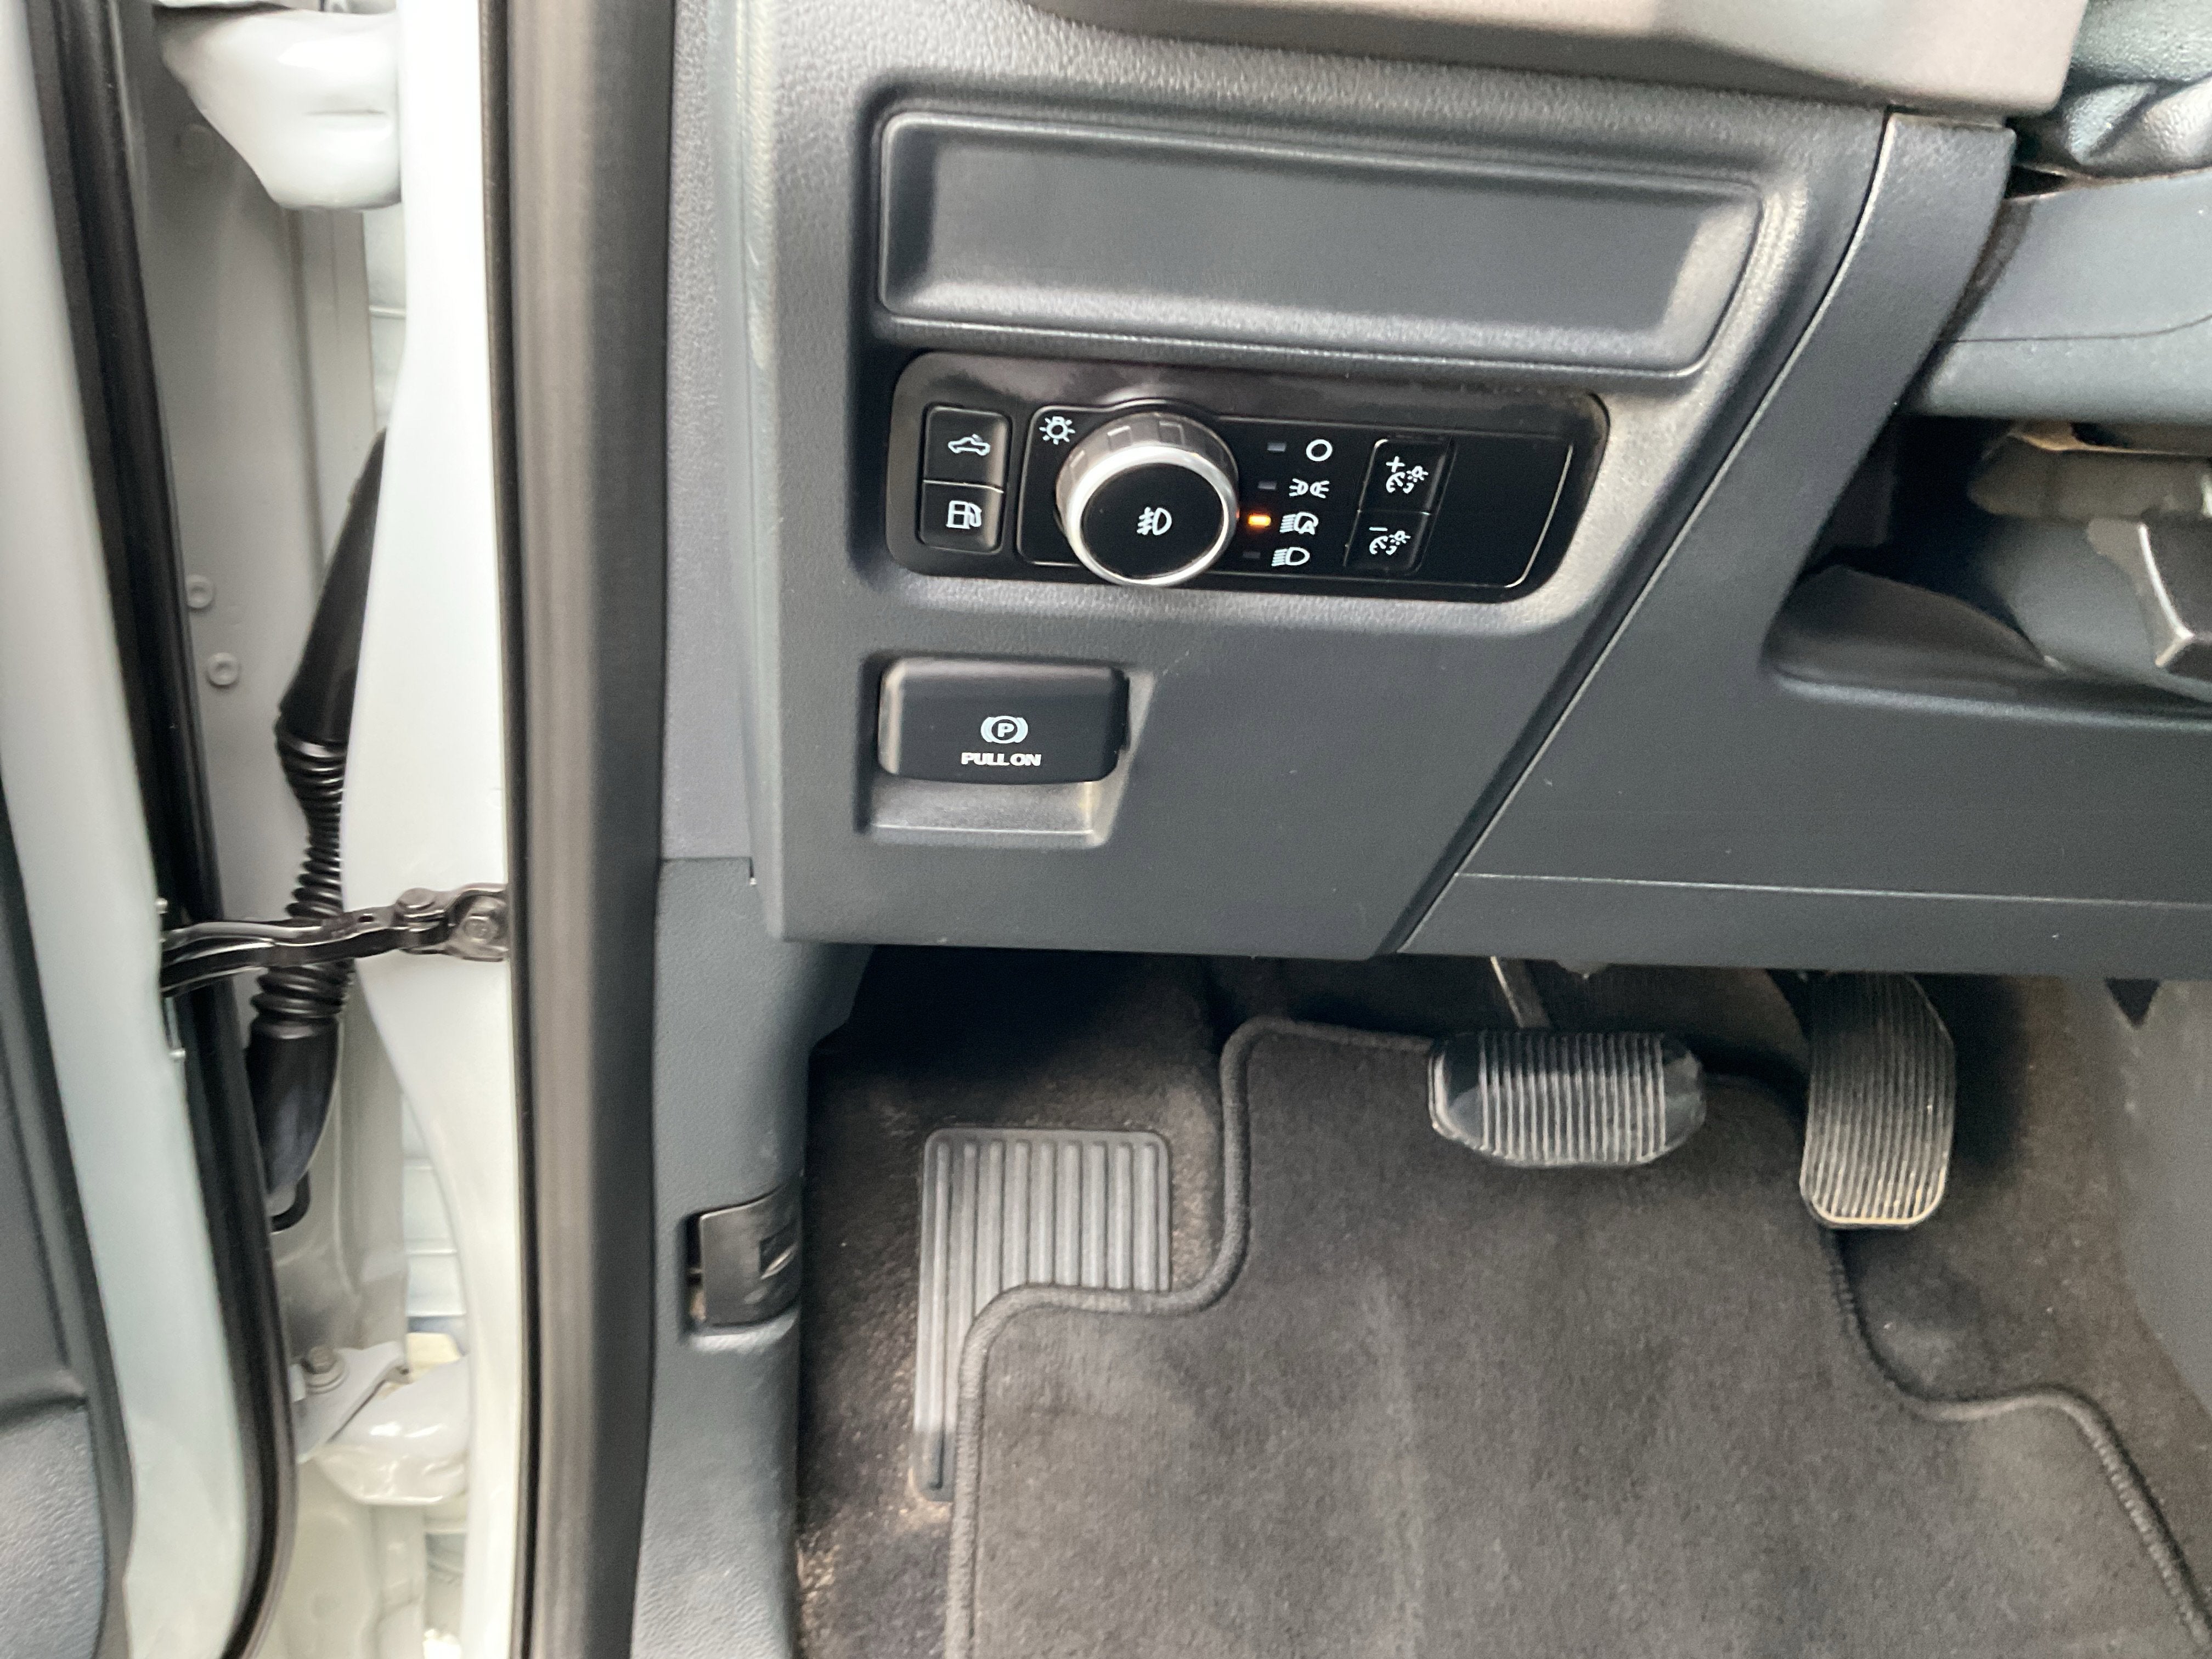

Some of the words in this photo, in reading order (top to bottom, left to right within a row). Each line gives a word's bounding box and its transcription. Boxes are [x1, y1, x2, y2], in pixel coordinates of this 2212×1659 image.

[997, 723, 1014, 737] P
[961, 752, 1009, 766] PULL
[1010, 753, 1042, 766] ON
